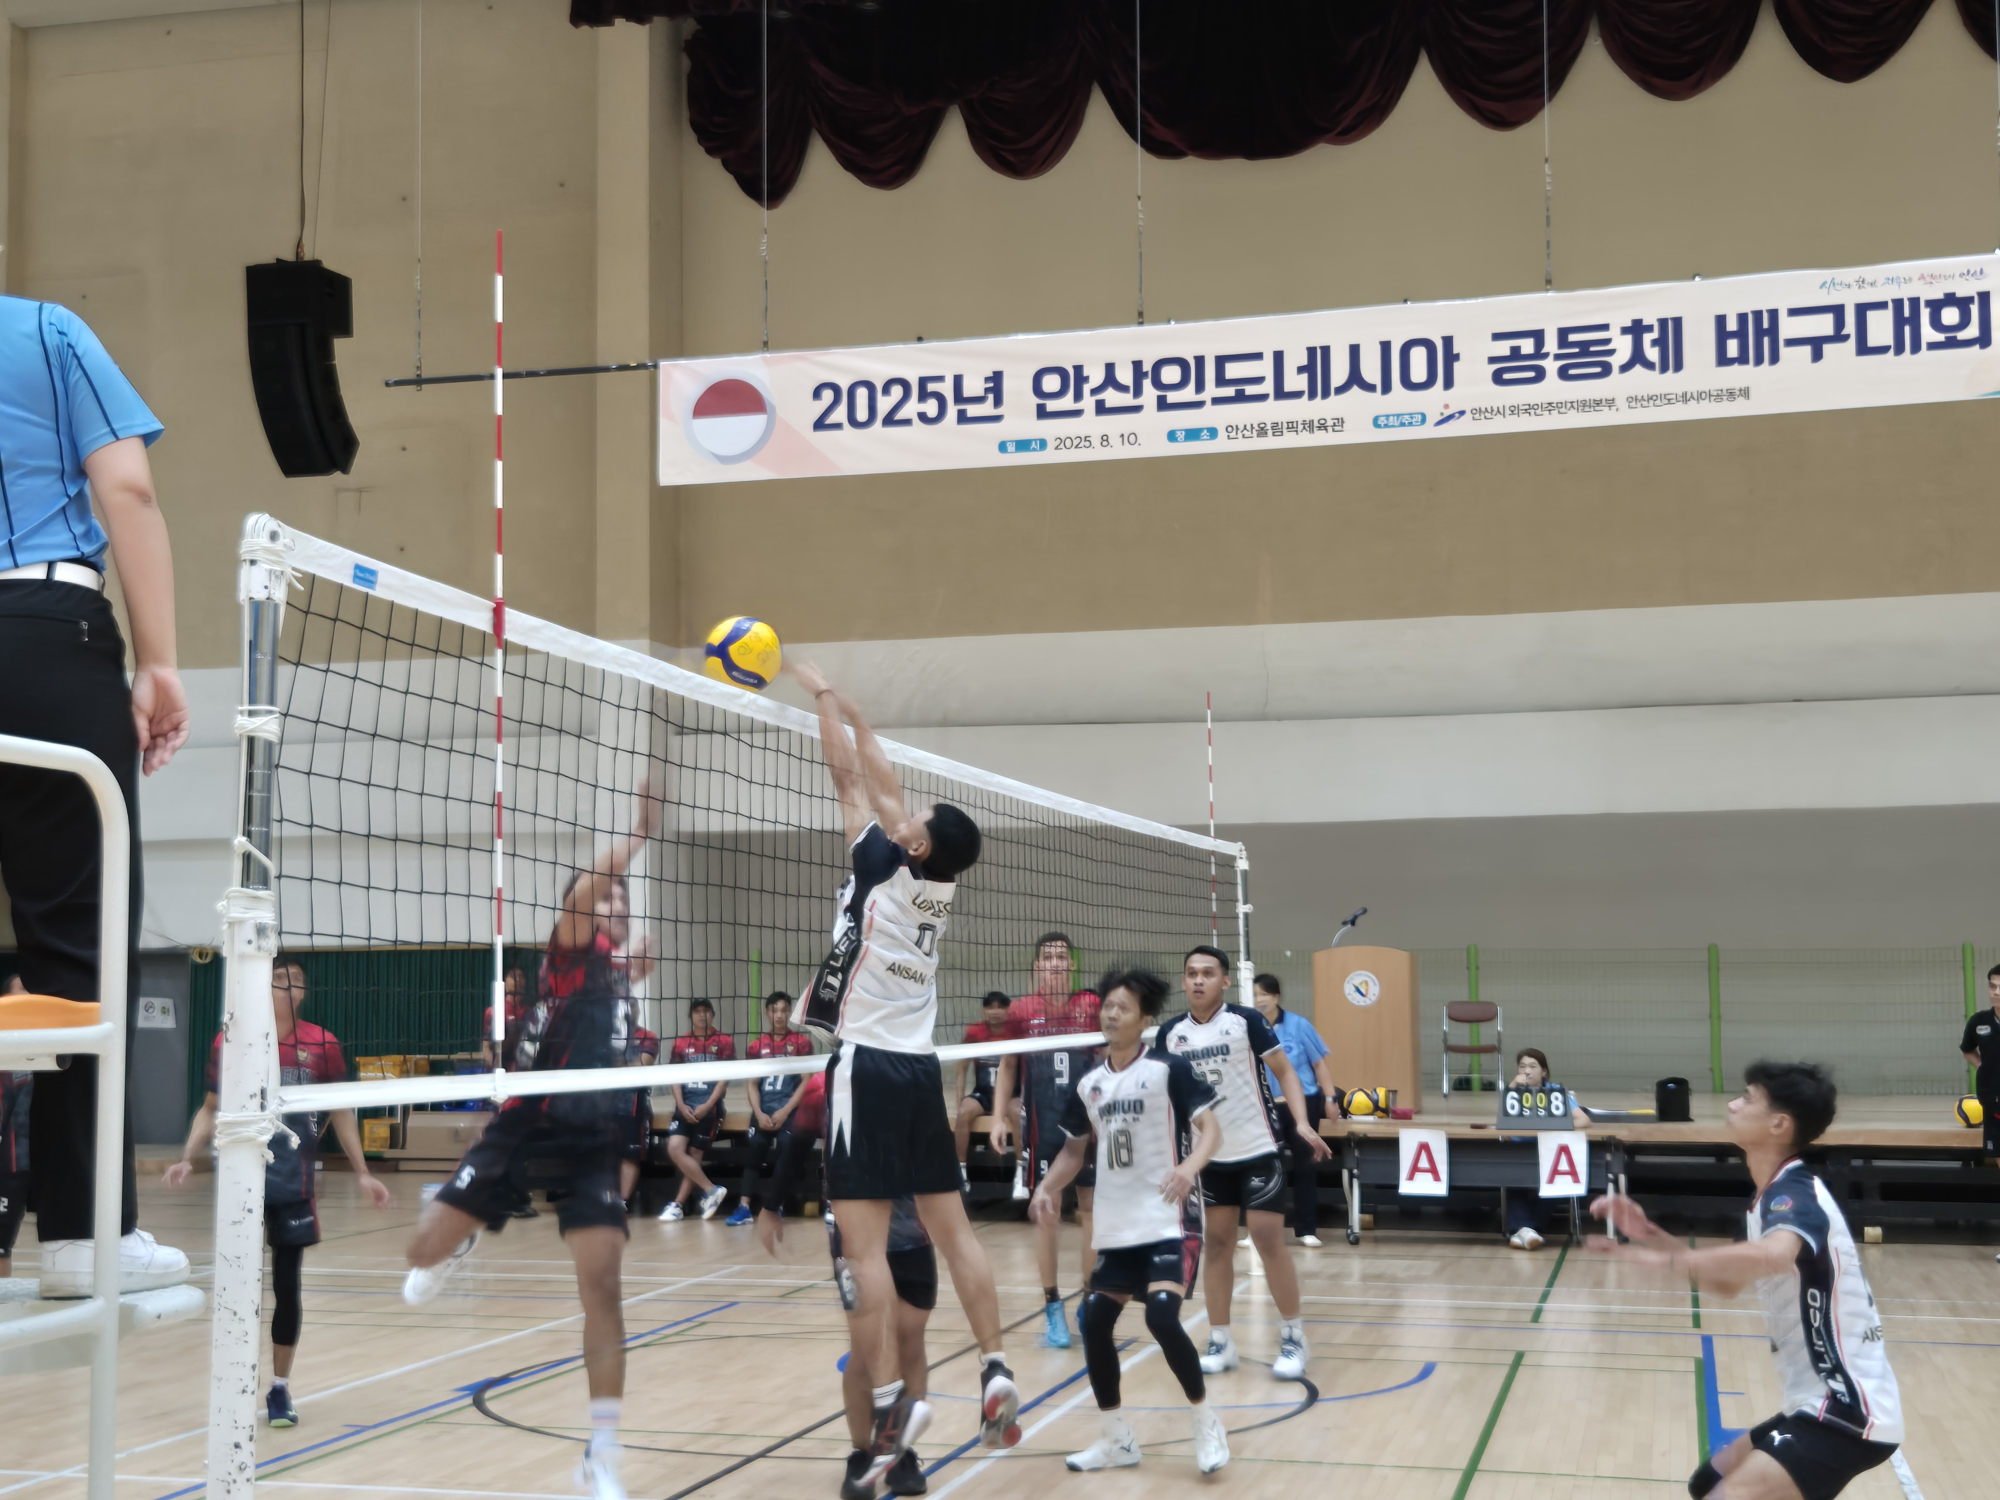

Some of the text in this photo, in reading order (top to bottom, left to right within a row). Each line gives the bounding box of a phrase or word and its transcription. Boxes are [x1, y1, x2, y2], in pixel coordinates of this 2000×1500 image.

[812, 290, 1993, 432] 2025년 안산인도네시아 공동체 배구대회
[1470, 404, 1506, 421] 안산시
[1626, 386, 1750, 411] 안산인도네시아공동체
[1225, 417, 1345, 441] 안산올림픽체육관
[886, 961, 926, 986] ANSAN
[1054, 1052, 1070, 1084] 9
[1506, 1090, 1520, 1116] 6
[1550, 1091, 1566, 1117] 8
[1405, 1140, 1442, 1183] A
[1545, 1143, 1582, 1185] A
